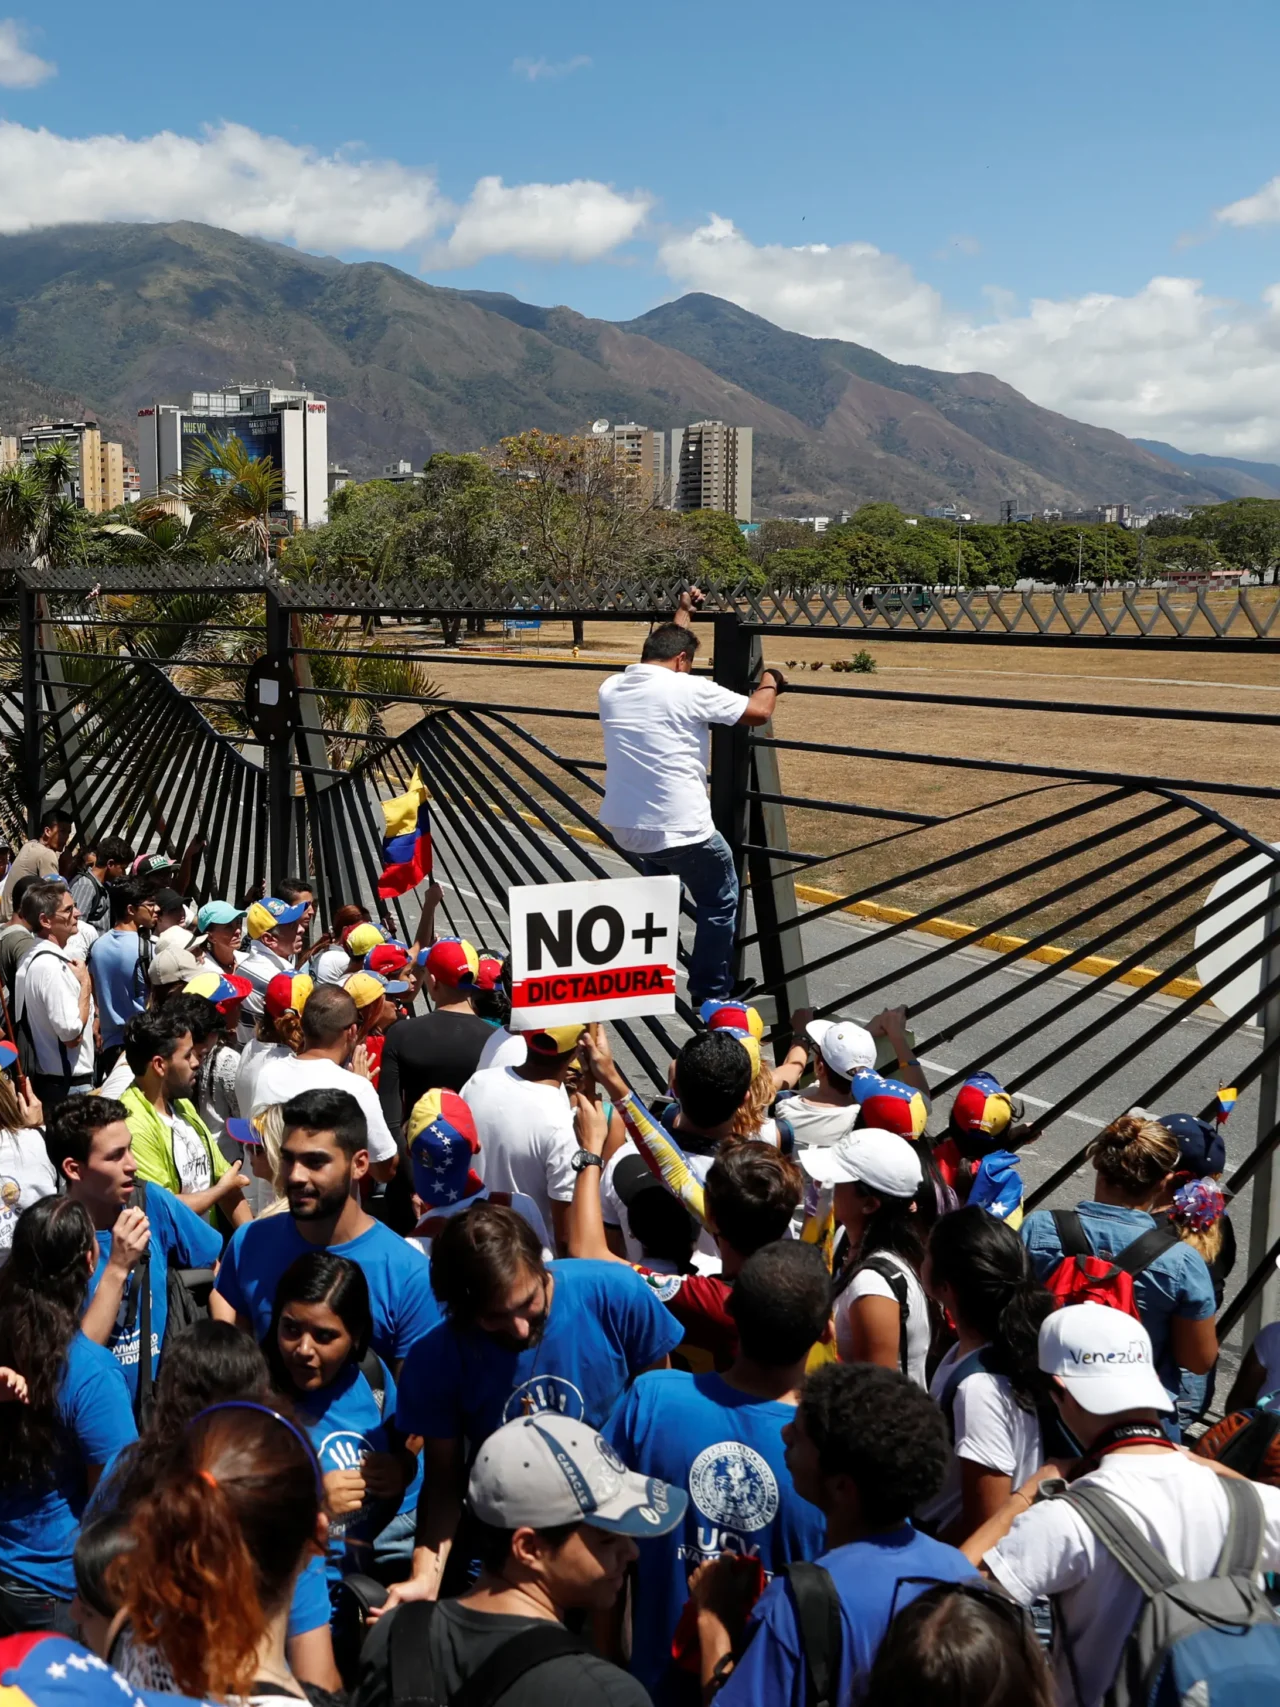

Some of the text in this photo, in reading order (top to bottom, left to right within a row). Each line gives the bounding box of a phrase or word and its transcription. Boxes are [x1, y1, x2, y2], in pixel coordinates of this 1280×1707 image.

[183, 421, 206, 434] NUEVO
[527, 968, 665, 1004] DICTADURA
[1070, 1347, 1151, 1365] Venezuel
[1114, 1426, 1162, 1439] Canon
[556, 1452, 590, 1507] CARACAS
[697, 1526, 761, 1557] UCV
